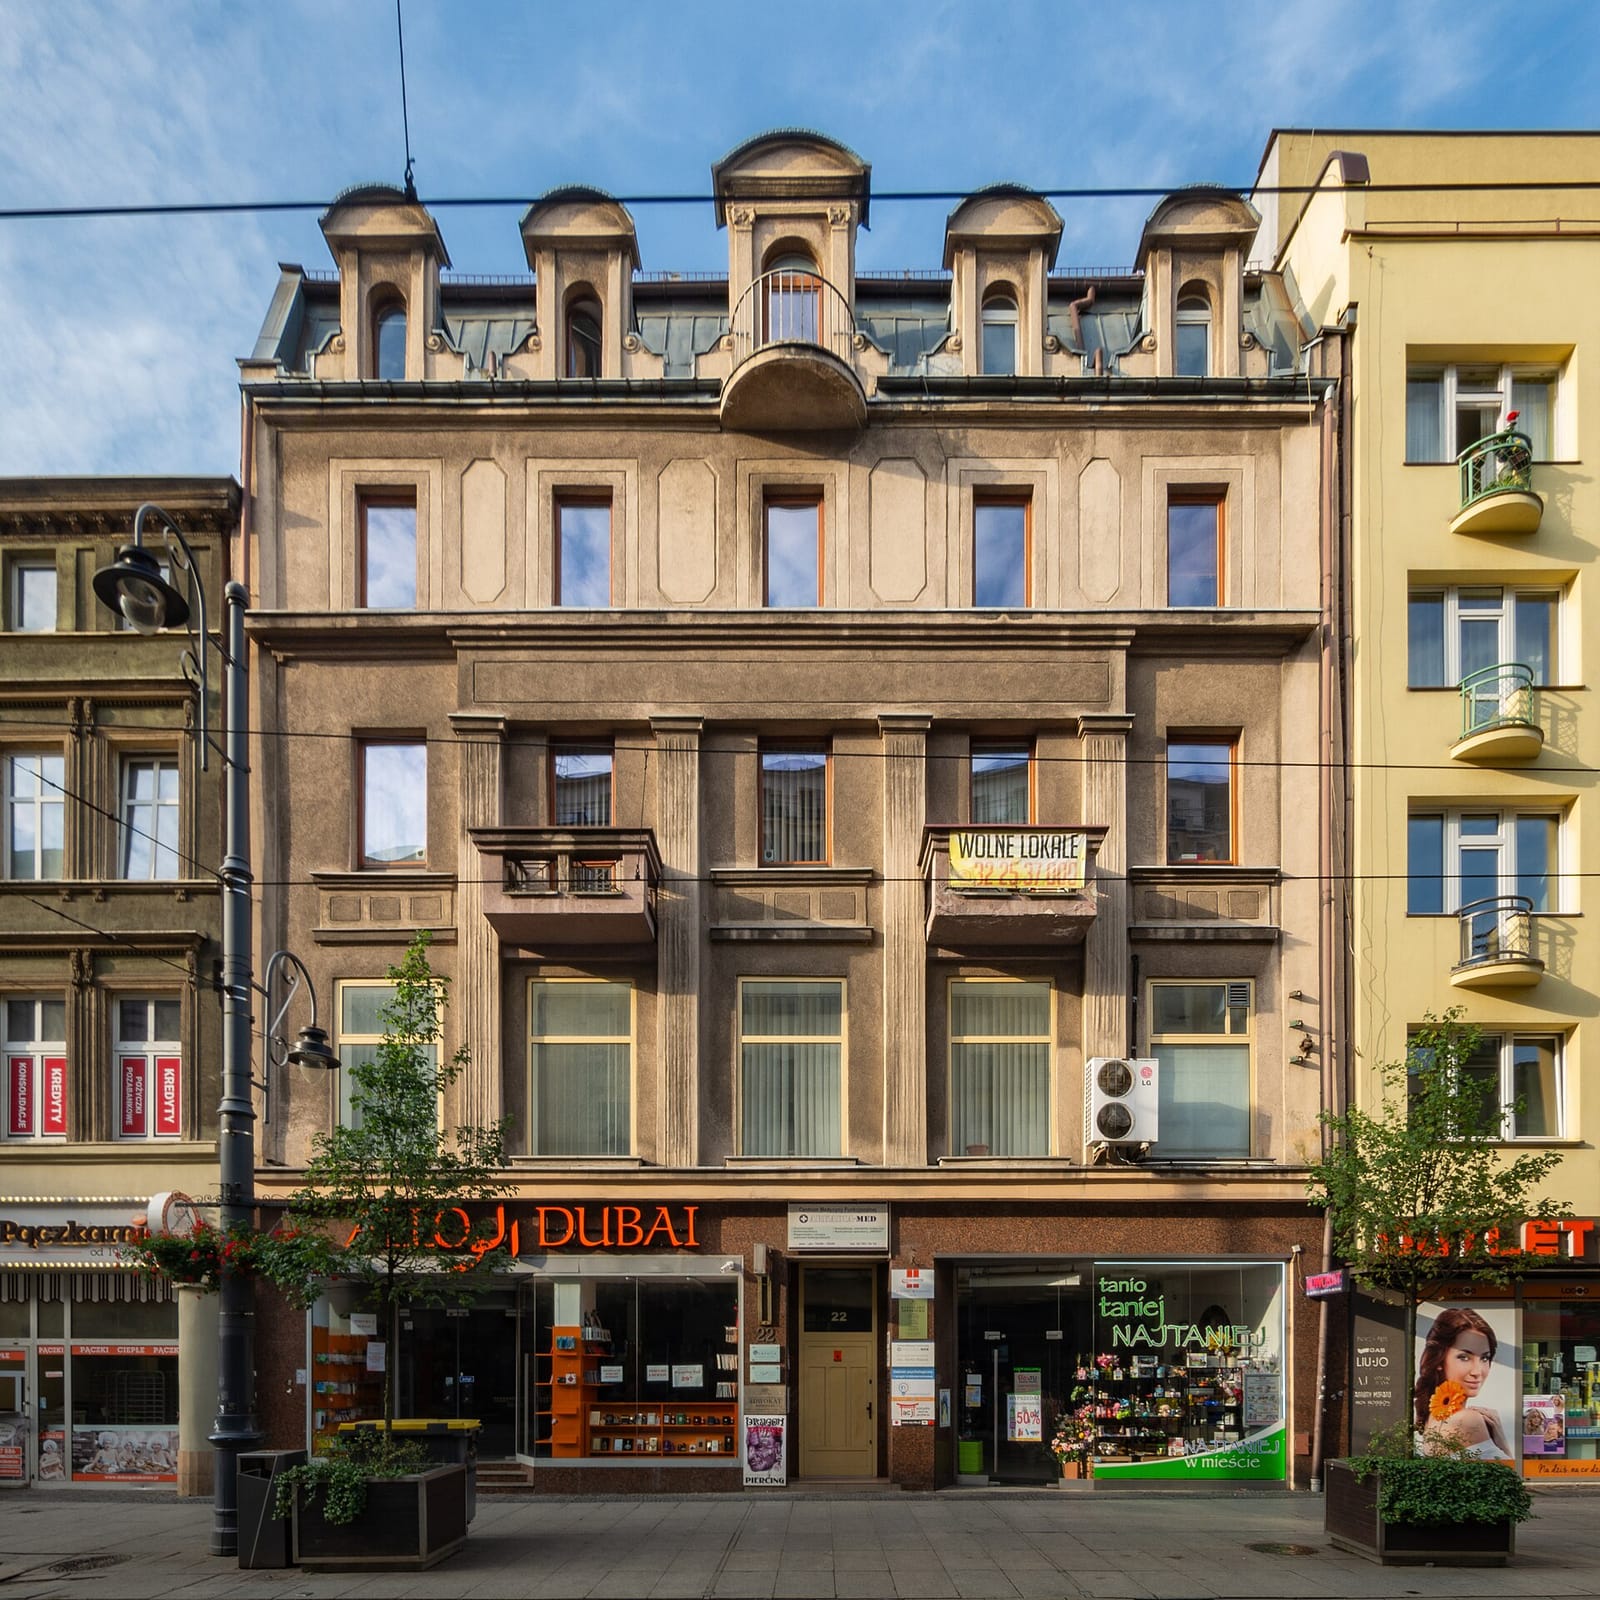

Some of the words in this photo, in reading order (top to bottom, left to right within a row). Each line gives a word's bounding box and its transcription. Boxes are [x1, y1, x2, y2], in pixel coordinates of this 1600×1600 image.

[958, 834, 1014, 859] WOLNE
[1021, 834, 1079, 859] LOKALE
[18, 1062, 27, 1129] KONSOLIDACJE
[51, 1068, 62, 1123] KREDYTY
[164, 1068, 174, 1124] KREDYTY
[536, 1206, 700, 1247] DUBAI
[1099, 1277, 1147, 1293] tanio
[831, 1311, 848, 1322] 22
[1099, 1295, 1164, 1332] taniej
[757, 1327, 776, 1342] 22
[1112, 1324, 1266, 1348] NAJTANIEJ
[153, 1346, 179, 1354] PĄCZK
[1016, 1410, 1041, 1425] 50%
[1184, 1440, 1280, 1454] NAJTANIEJ
[1184, 1458, 1198, 1468] w
[1202, 1455, 1261, 1468] mieście
